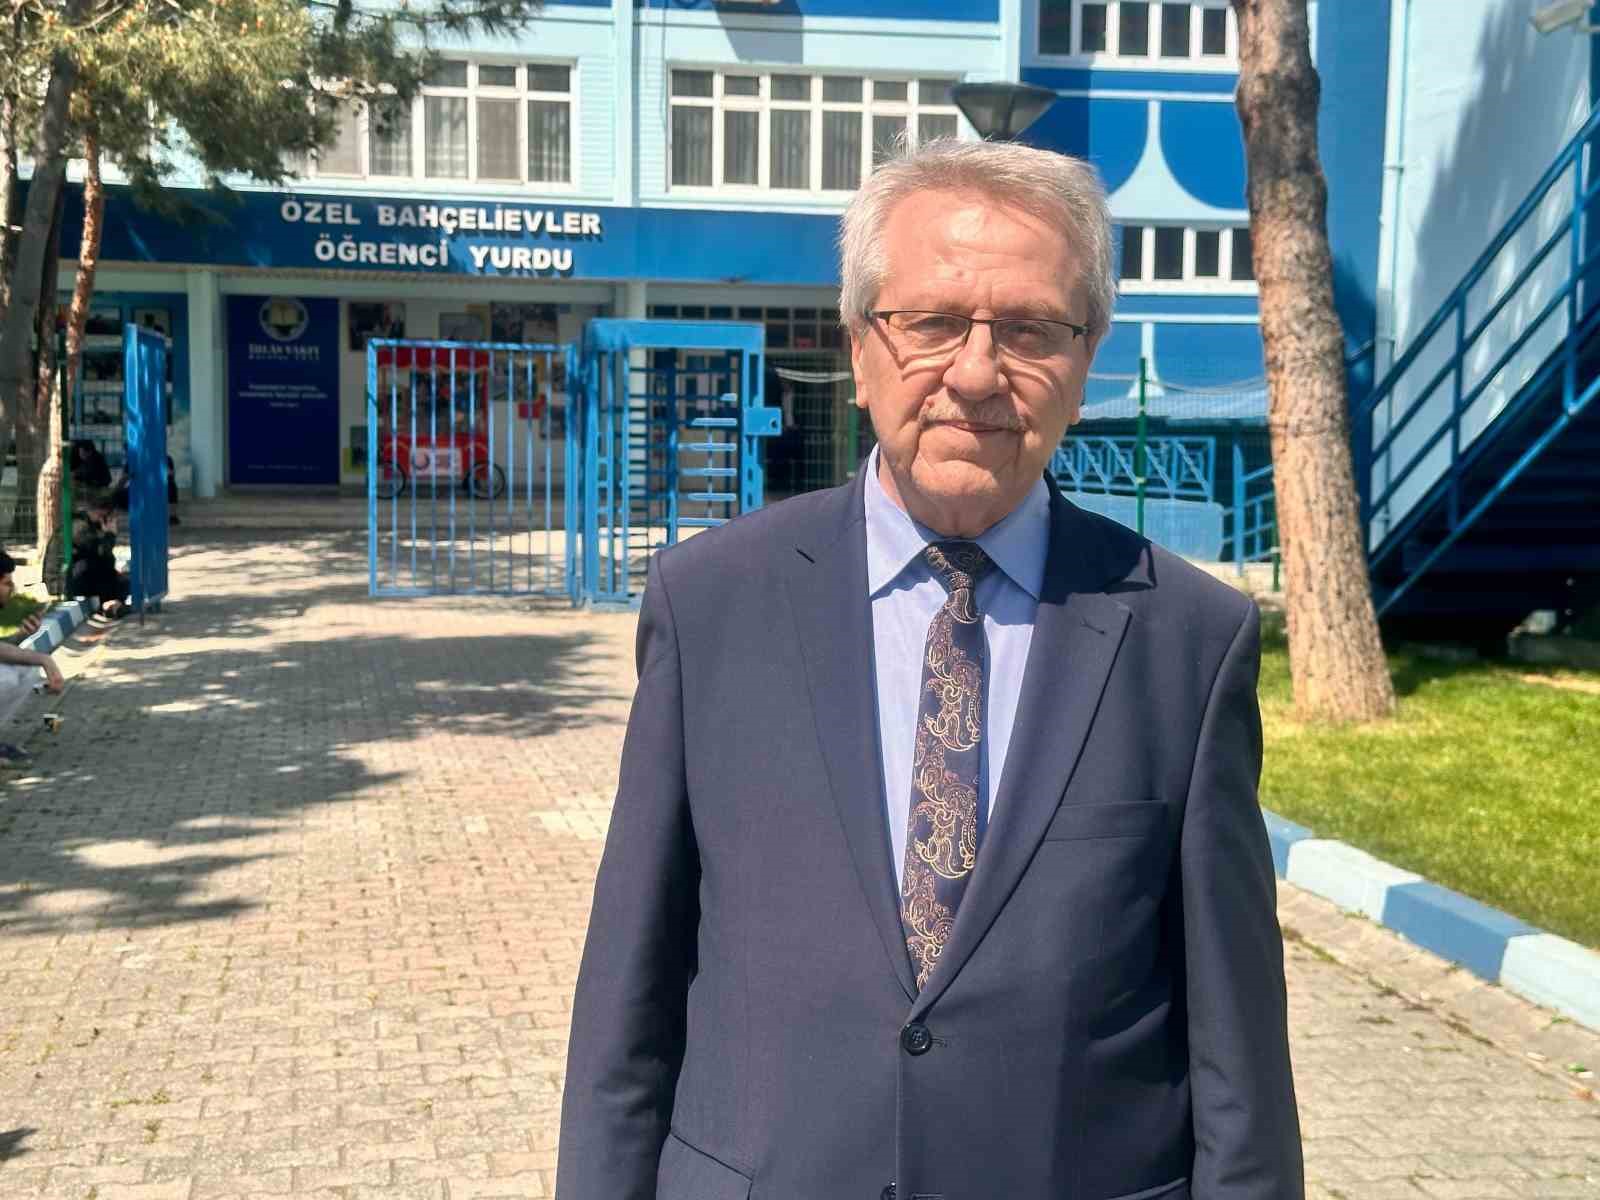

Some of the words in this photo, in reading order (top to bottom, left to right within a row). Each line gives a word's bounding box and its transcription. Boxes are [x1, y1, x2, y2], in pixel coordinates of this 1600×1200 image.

[281, 196, 360, 225] ÖZEL
[378, 204, 601, 235] BAHÇELİEVLER
[314, 232, 448, 266] ÖĞRENCİ
[469, 245, 573, 270] YURDU
